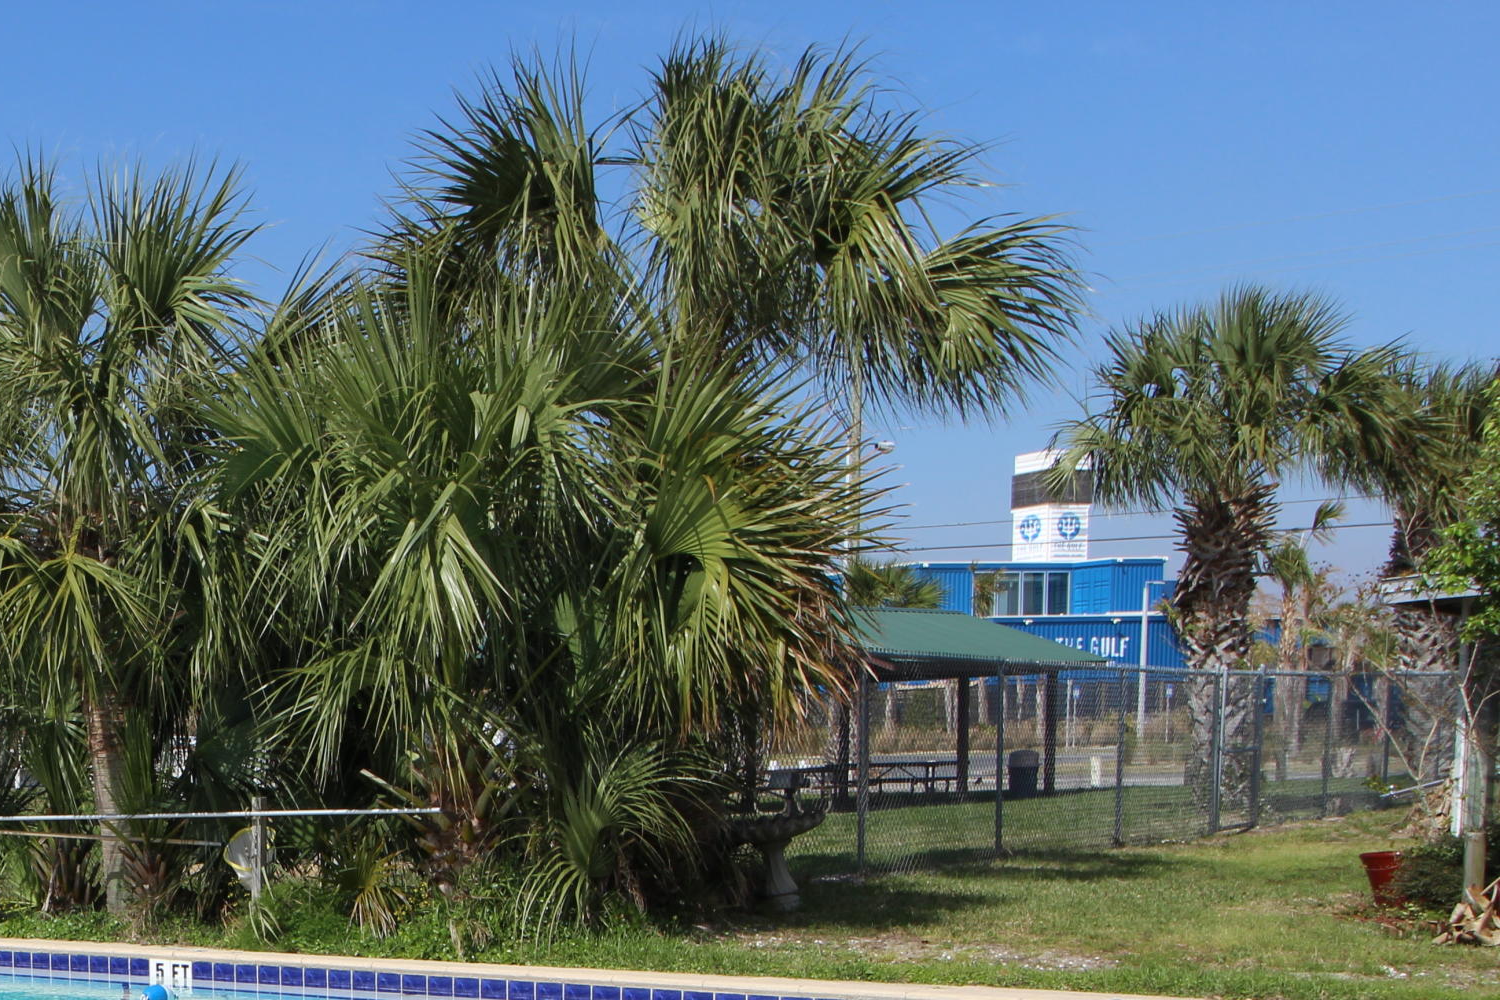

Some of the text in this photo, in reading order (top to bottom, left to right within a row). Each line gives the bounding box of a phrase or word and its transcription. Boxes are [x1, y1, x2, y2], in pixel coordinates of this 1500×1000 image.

[1090, 636, 1130, 658] GULF
[155, 962, 189, 980] 5 FT
